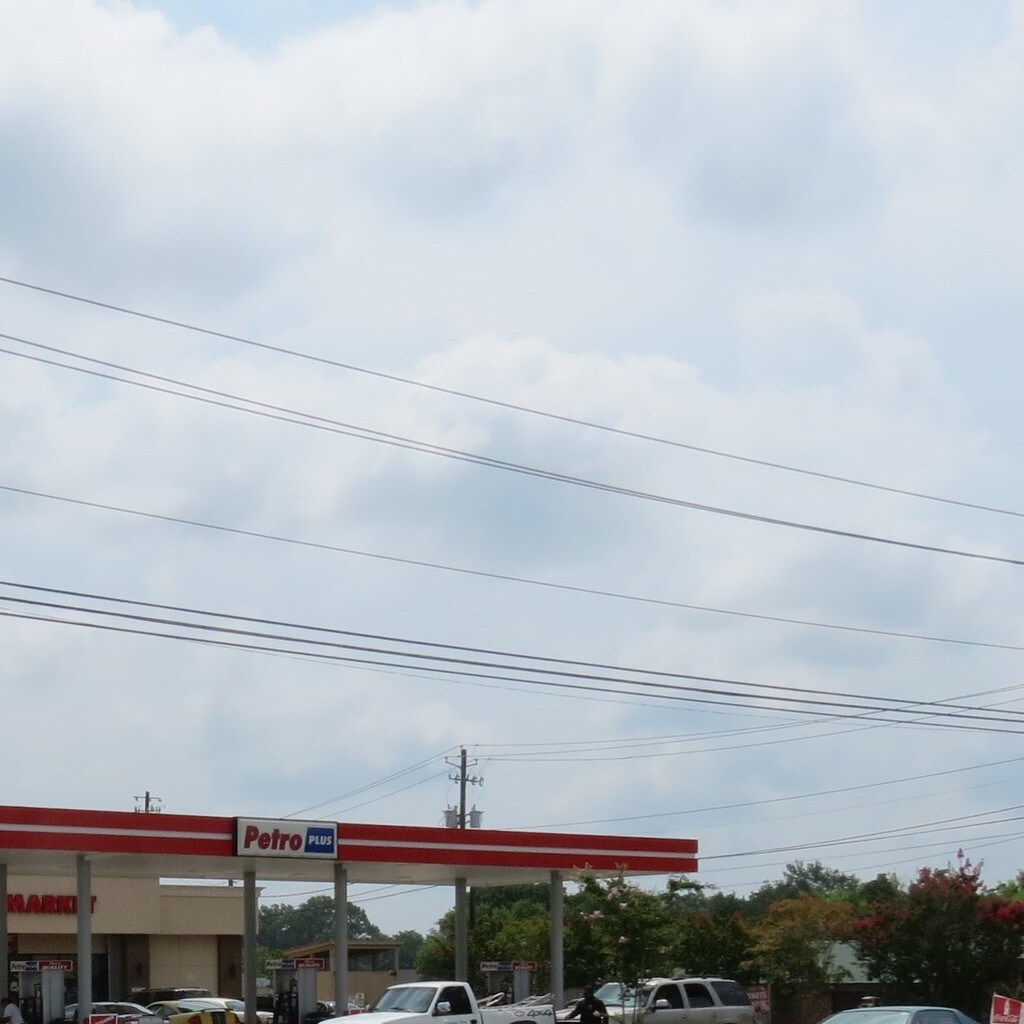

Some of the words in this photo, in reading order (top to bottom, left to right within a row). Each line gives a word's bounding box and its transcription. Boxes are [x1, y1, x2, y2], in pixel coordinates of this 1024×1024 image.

[243, 825, 303, 852] Petro
[308, 835, 332, 846] PLUS
[7, 893, 97, 914] MARKT
